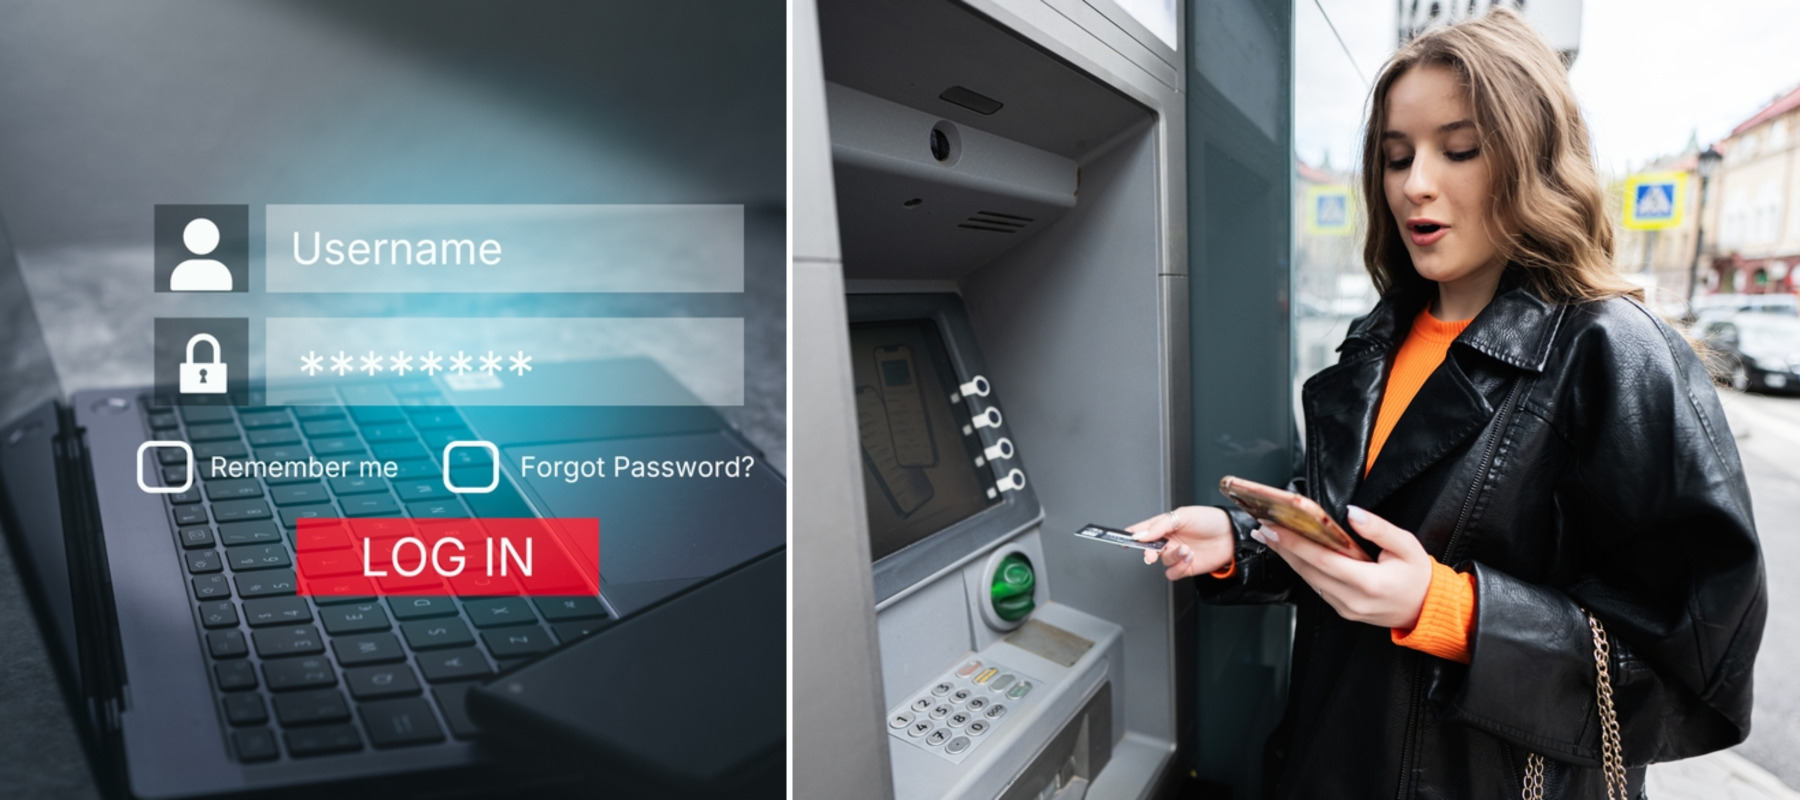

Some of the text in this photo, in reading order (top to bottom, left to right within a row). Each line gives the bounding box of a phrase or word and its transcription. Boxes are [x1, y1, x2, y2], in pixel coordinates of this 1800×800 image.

[937, 684, 950, 692] 3
[917, 699, 931, 708] 2
[971, 699, 983, 707] 9
[935, 707, 948, 715] 5
[953, 714, 966, 723] 8
[916, 724, 928, 732] 4
[971, 723, 984, 732] 0
[932, 731, 944, 740] 7
